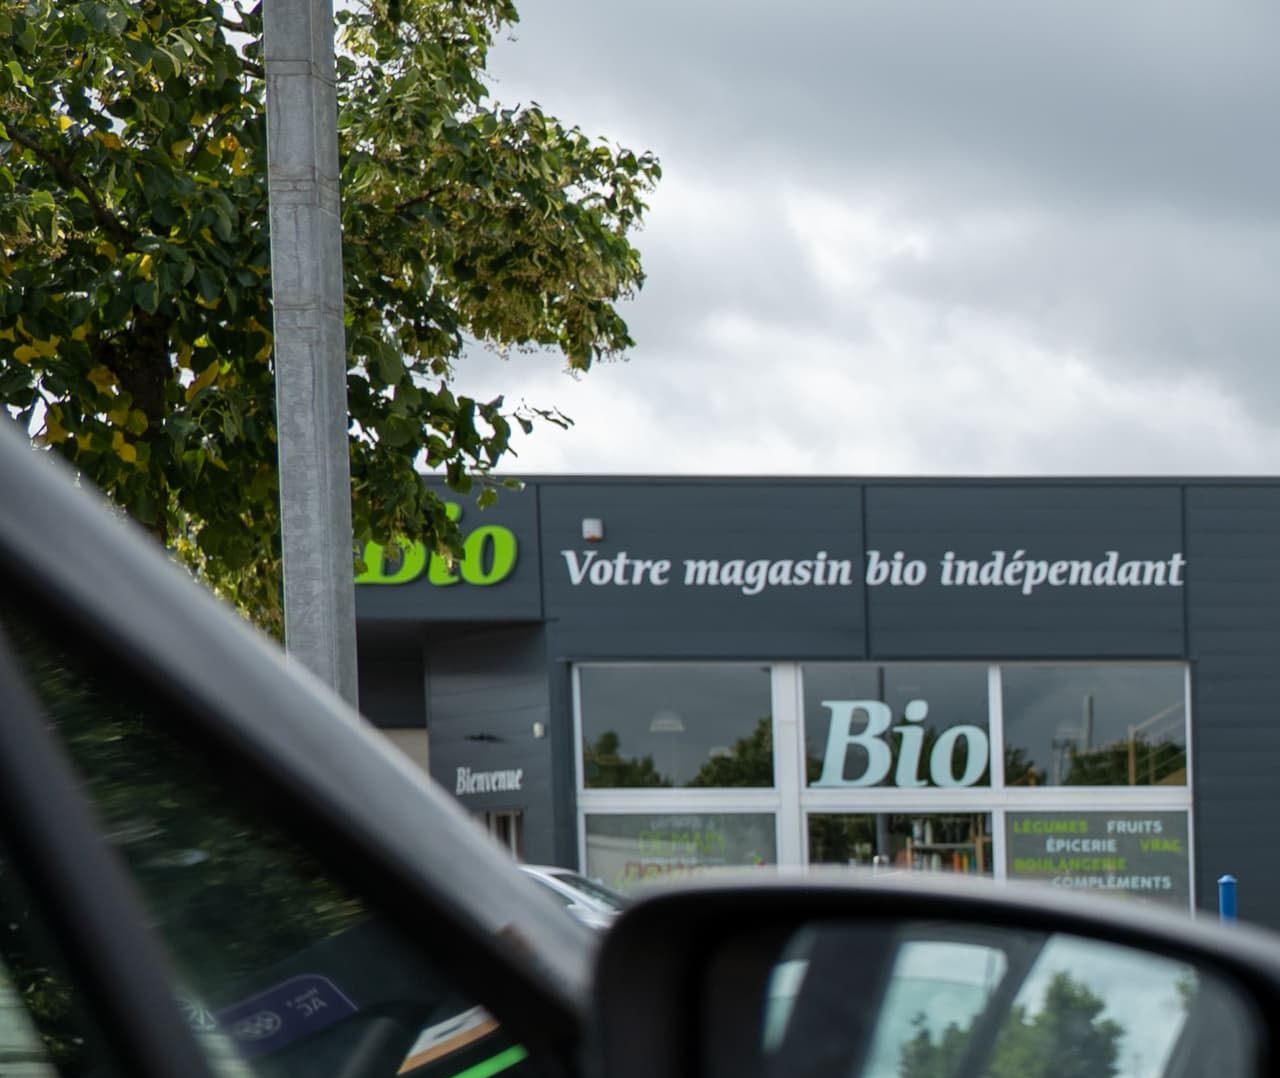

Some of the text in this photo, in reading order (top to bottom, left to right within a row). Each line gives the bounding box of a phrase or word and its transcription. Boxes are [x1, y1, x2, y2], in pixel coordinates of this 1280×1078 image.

[561, 549, 1186, 595] Votre magasin bio indépendant
[809, 699, 989, 788] Bio
[456, 766, 523, 796] Bienvenue
[1013, 819, 1162, 834] LÉGUMES FRUITS
[1046, 837, 1181, 853] ÉPICERIE VRAC
[1014, 858, 1127, 872] BOULANGERIE
[1053, 873, 1172, 890] COMPLÉMENTS
